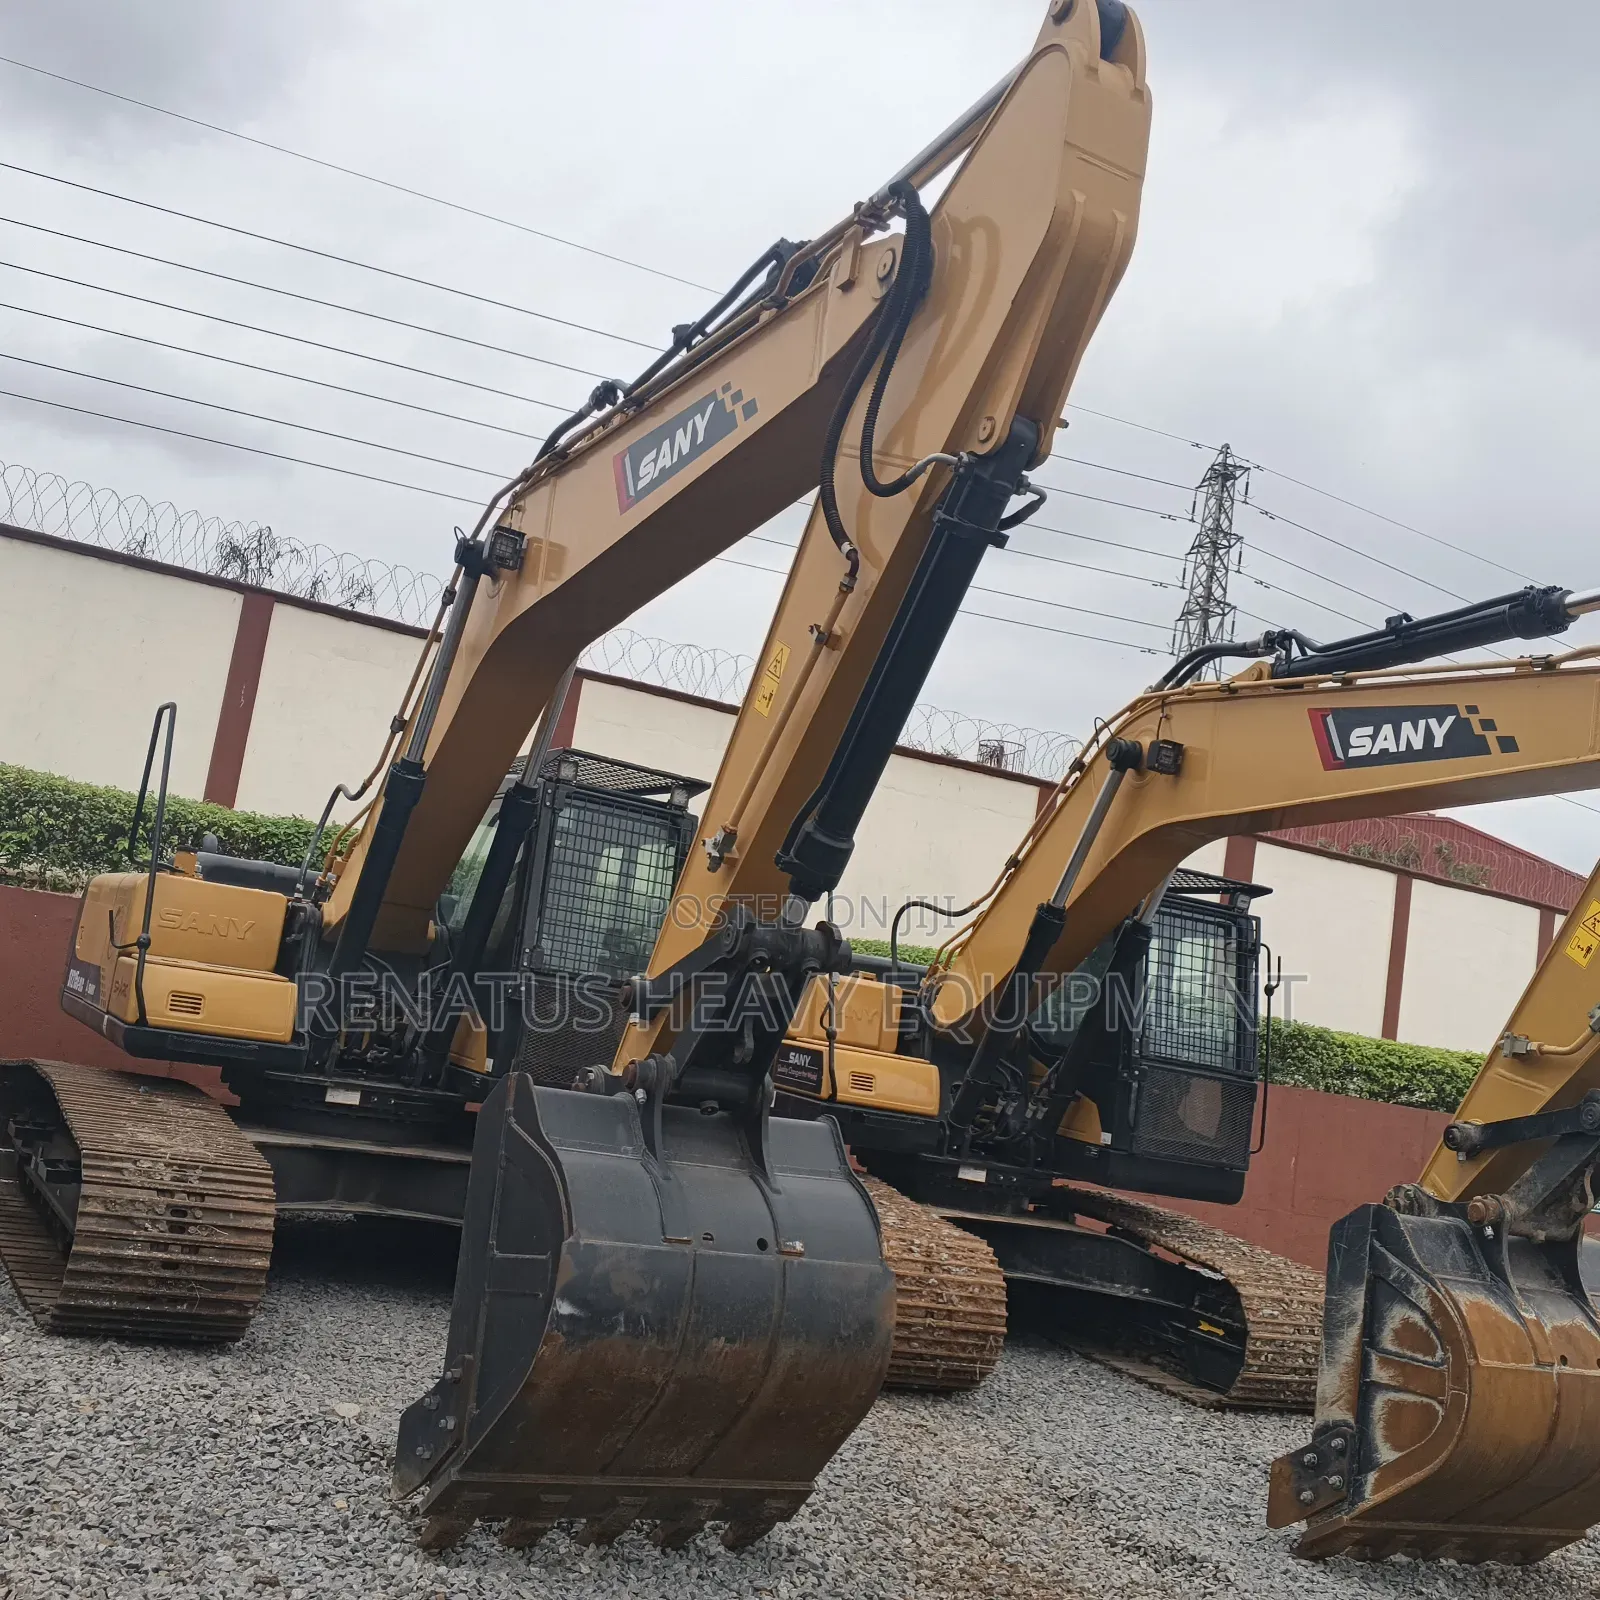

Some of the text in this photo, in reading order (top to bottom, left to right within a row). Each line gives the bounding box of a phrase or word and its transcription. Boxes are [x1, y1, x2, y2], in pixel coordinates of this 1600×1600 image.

[637, 401, 716, 491] SANY
[1348, 715, 1457, 758] SANY
[158, 907, 255, 940] SANY
[789, 1051, 812, 1067] SANY
